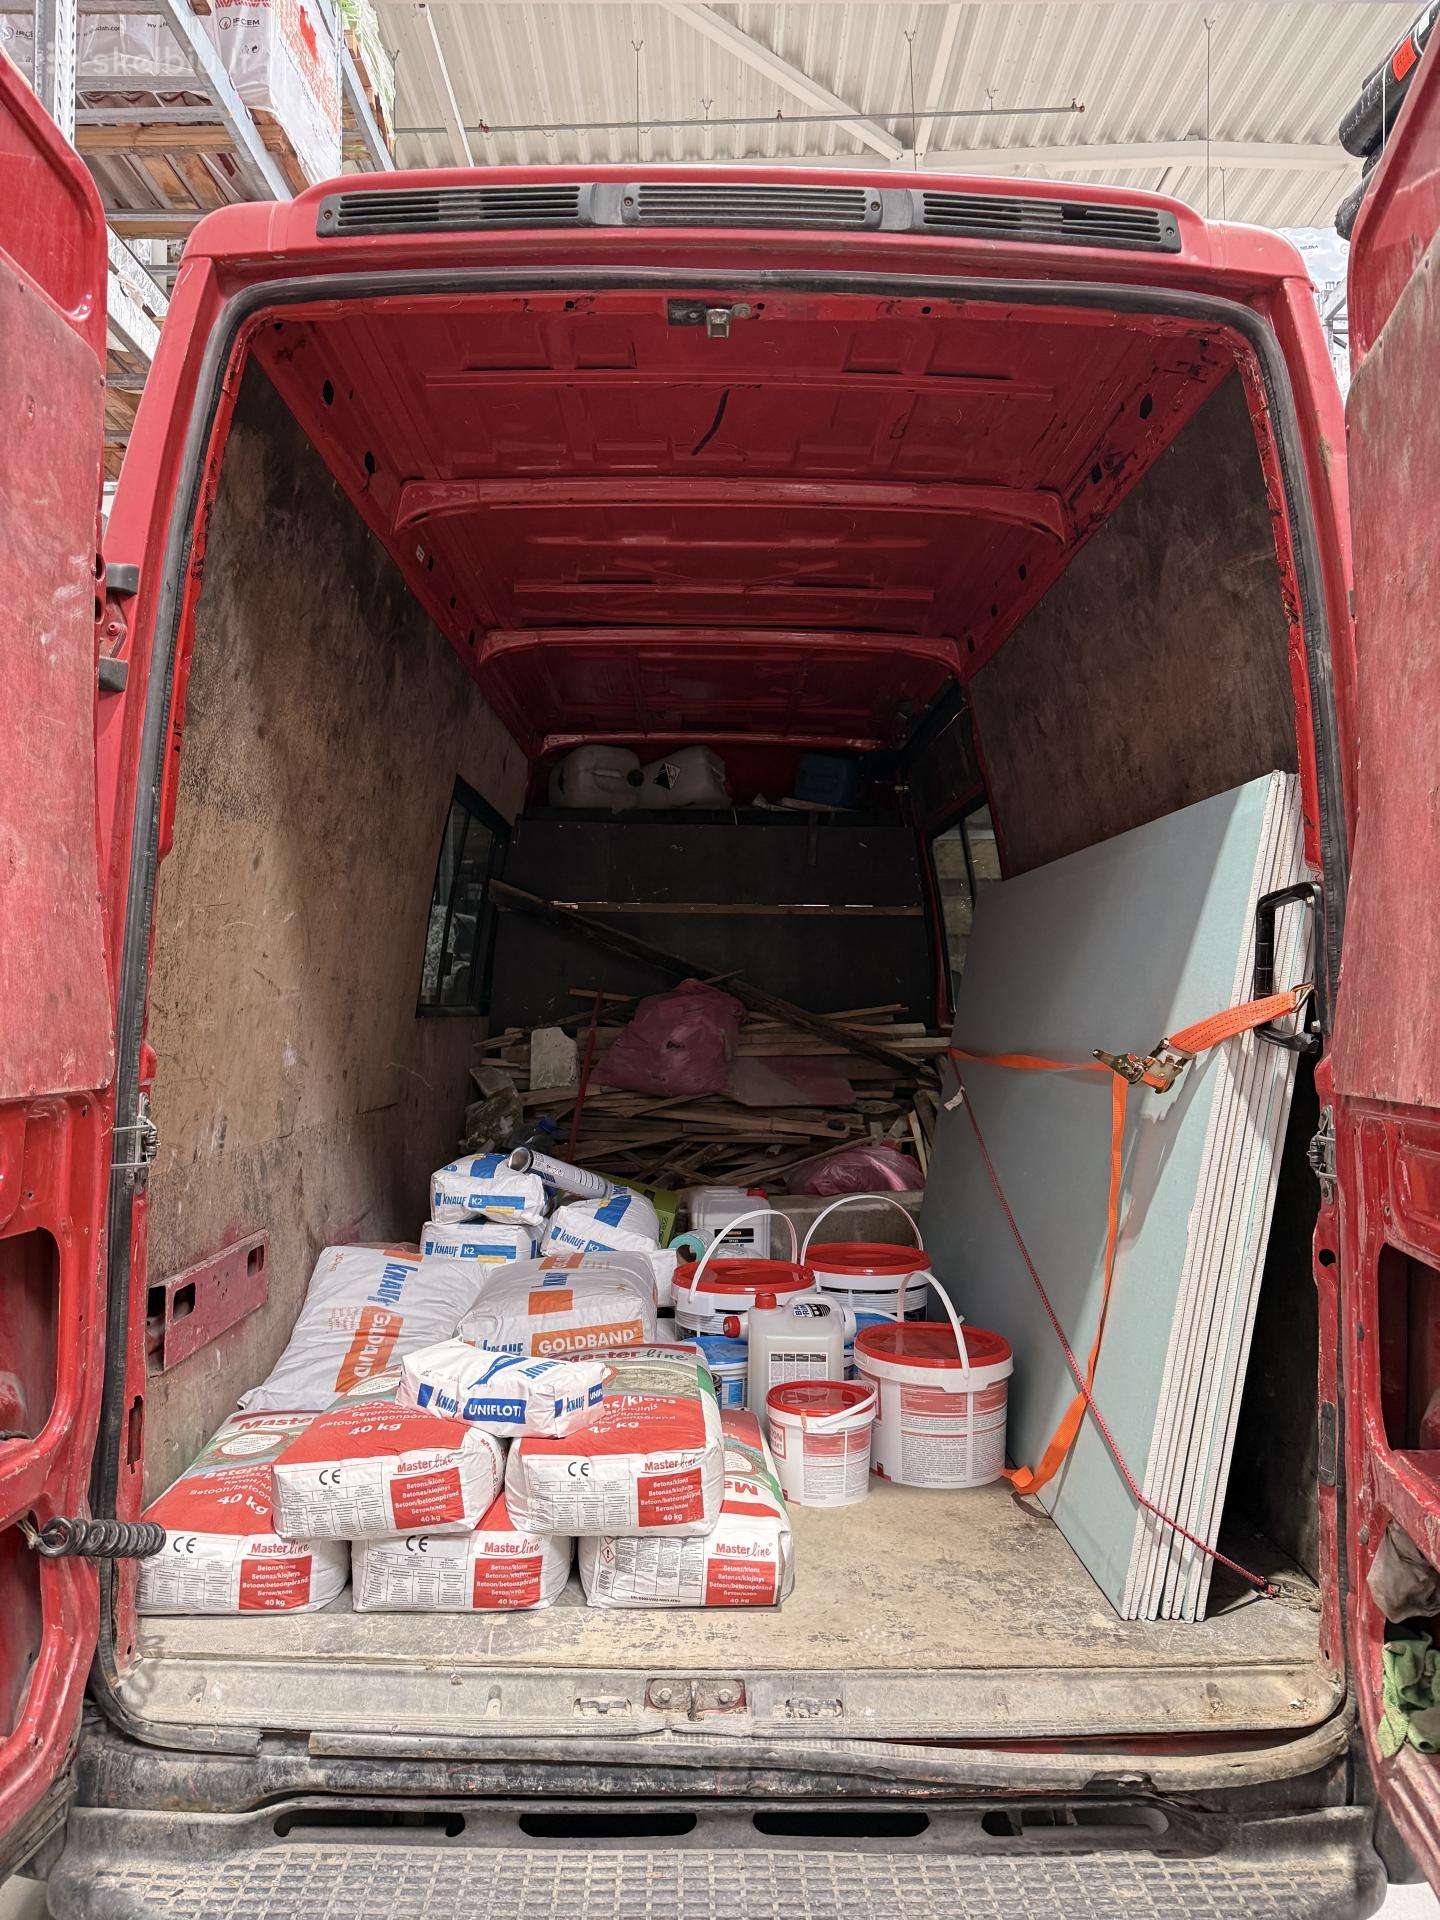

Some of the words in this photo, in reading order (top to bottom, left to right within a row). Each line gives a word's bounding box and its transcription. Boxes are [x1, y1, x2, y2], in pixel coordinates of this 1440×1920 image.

[471, 1197, 483, 1205] K2
[559, 1229, 586, 1250] KNAUF
[434, 1243, 459, 1257] KNAUF
[463, 1247, 475, 1255] K2
[538, 1329, 636, 1354] GOLDBAND
[468, 1403, 522, 1417] UNIFLOT
[348, 1424, 373, 1435] 40
[377, 1421, 402, 1432] kg
[397, 1459, 433, 1473] Master
[567, 1461, 590, 1477] CE
[644, 1459, 680, 1471] Master
[319, 1468, 341, 1485] CE
[216, 1493, 243, 1505] 40
[245, 1495, 270, 1515] kg
[431, 1515, 441, 1523] kg
[673, 1513, 683, 1521] kg
[173, 1536, 197, 1554] CE
[250, 1543, 288, 1554] Master
[405, 1534, 429, 1553] CE
[484, 1542, 520, 1553] Master
[716, 1543, 751, 1555] Master
[275, 1598, 286, 1607] kg
[508, 1598, 519, 1606] kg
